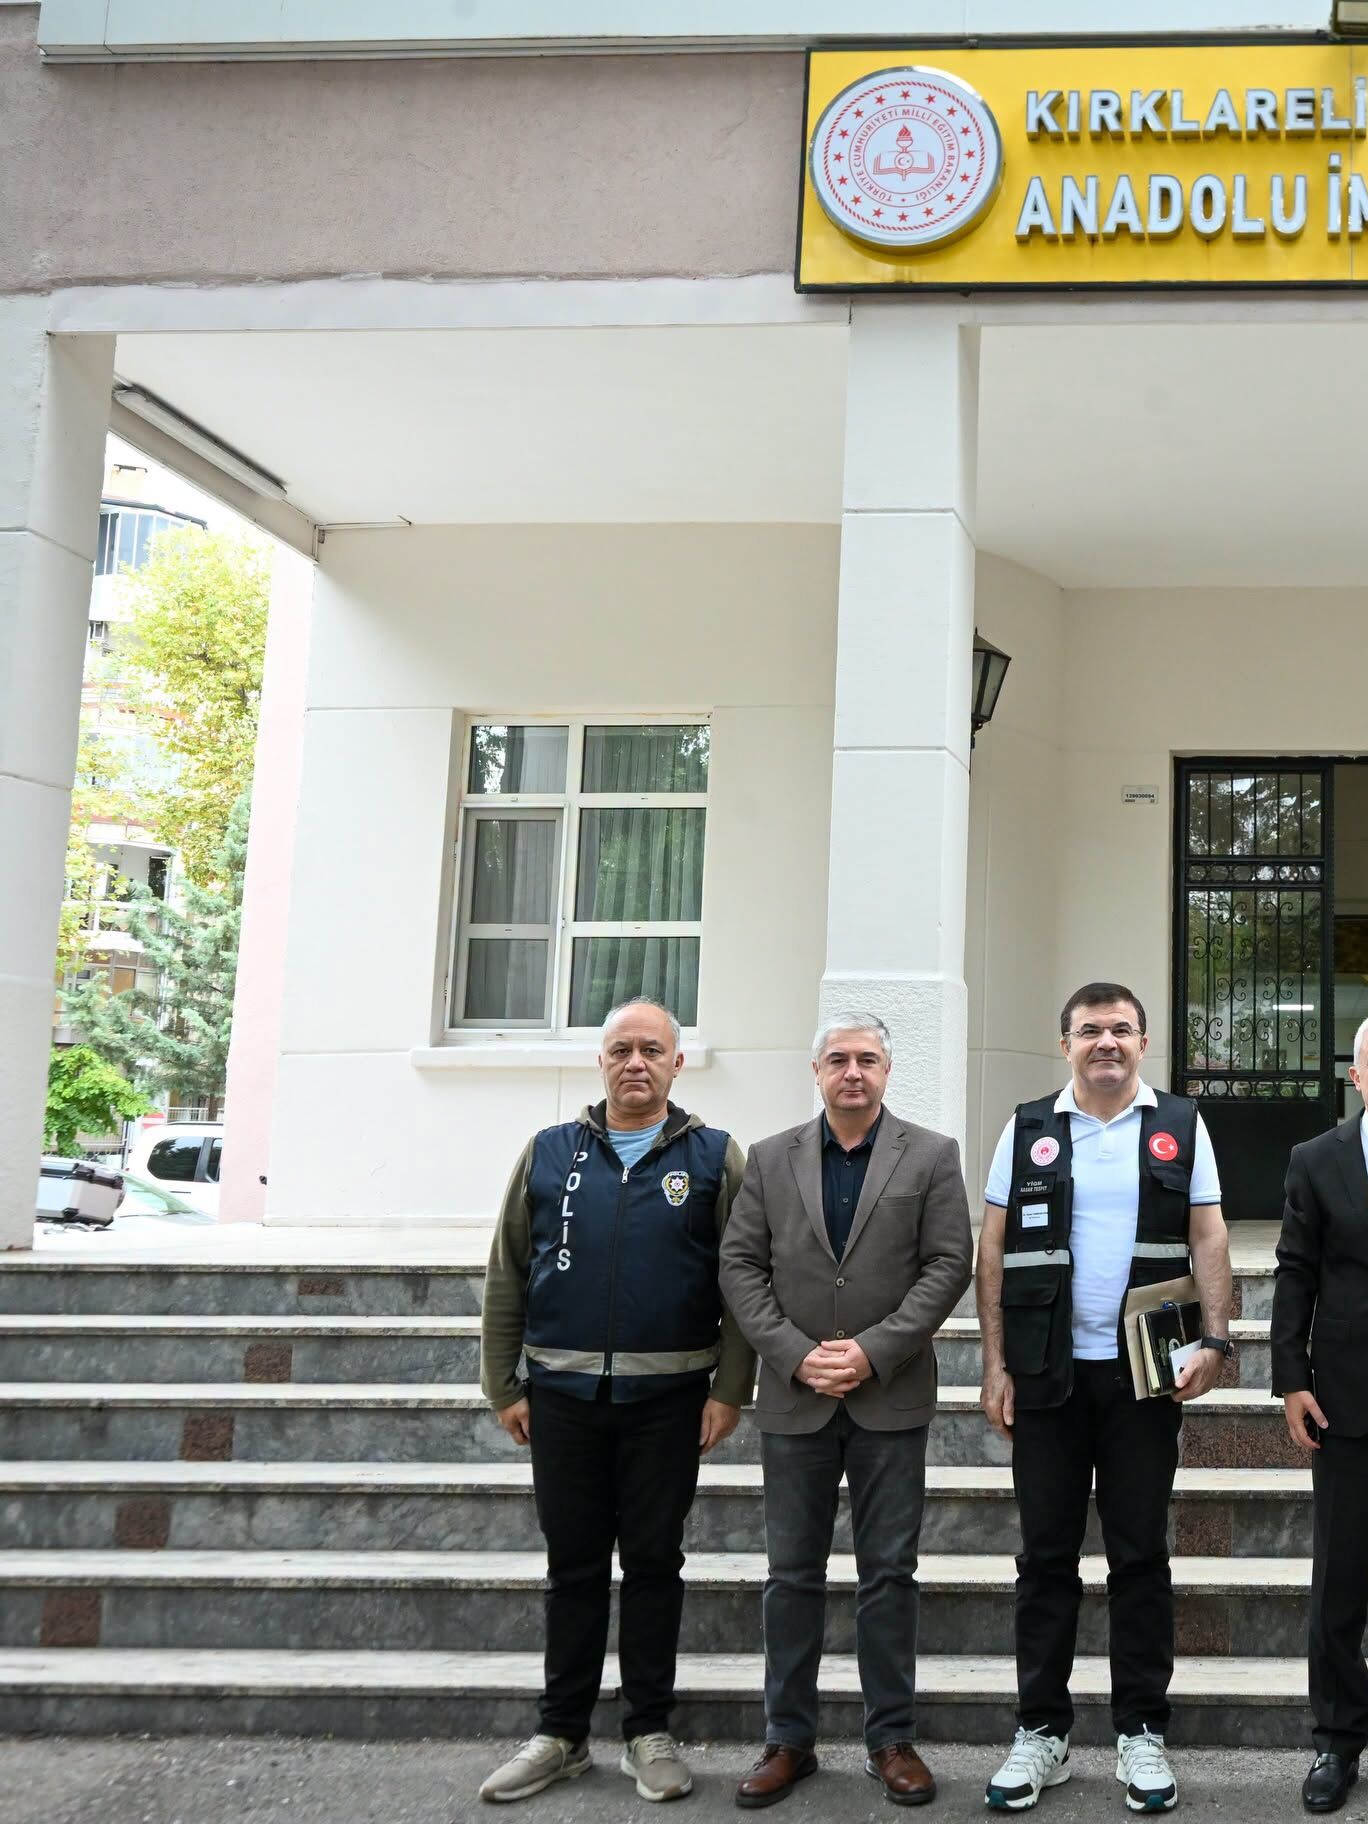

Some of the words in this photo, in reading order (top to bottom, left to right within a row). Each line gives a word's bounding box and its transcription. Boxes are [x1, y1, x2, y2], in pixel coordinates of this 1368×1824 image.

[901, 107, 932, 121] MİLLİ
[932, 118, 955, 151] EĞİTİM
[1025, 76, 1368, 140] KIRKLARELİ
[853, 108, 898, 168] CUMHURİYETİ
[856, 170, 894, 203] TÜRKİYE
[915, 155, 956, 201] BAKANLIĞI
[1014, 173, 1308, 242] ANADOLU
[556, 1150, 589, 1272] POLİS
